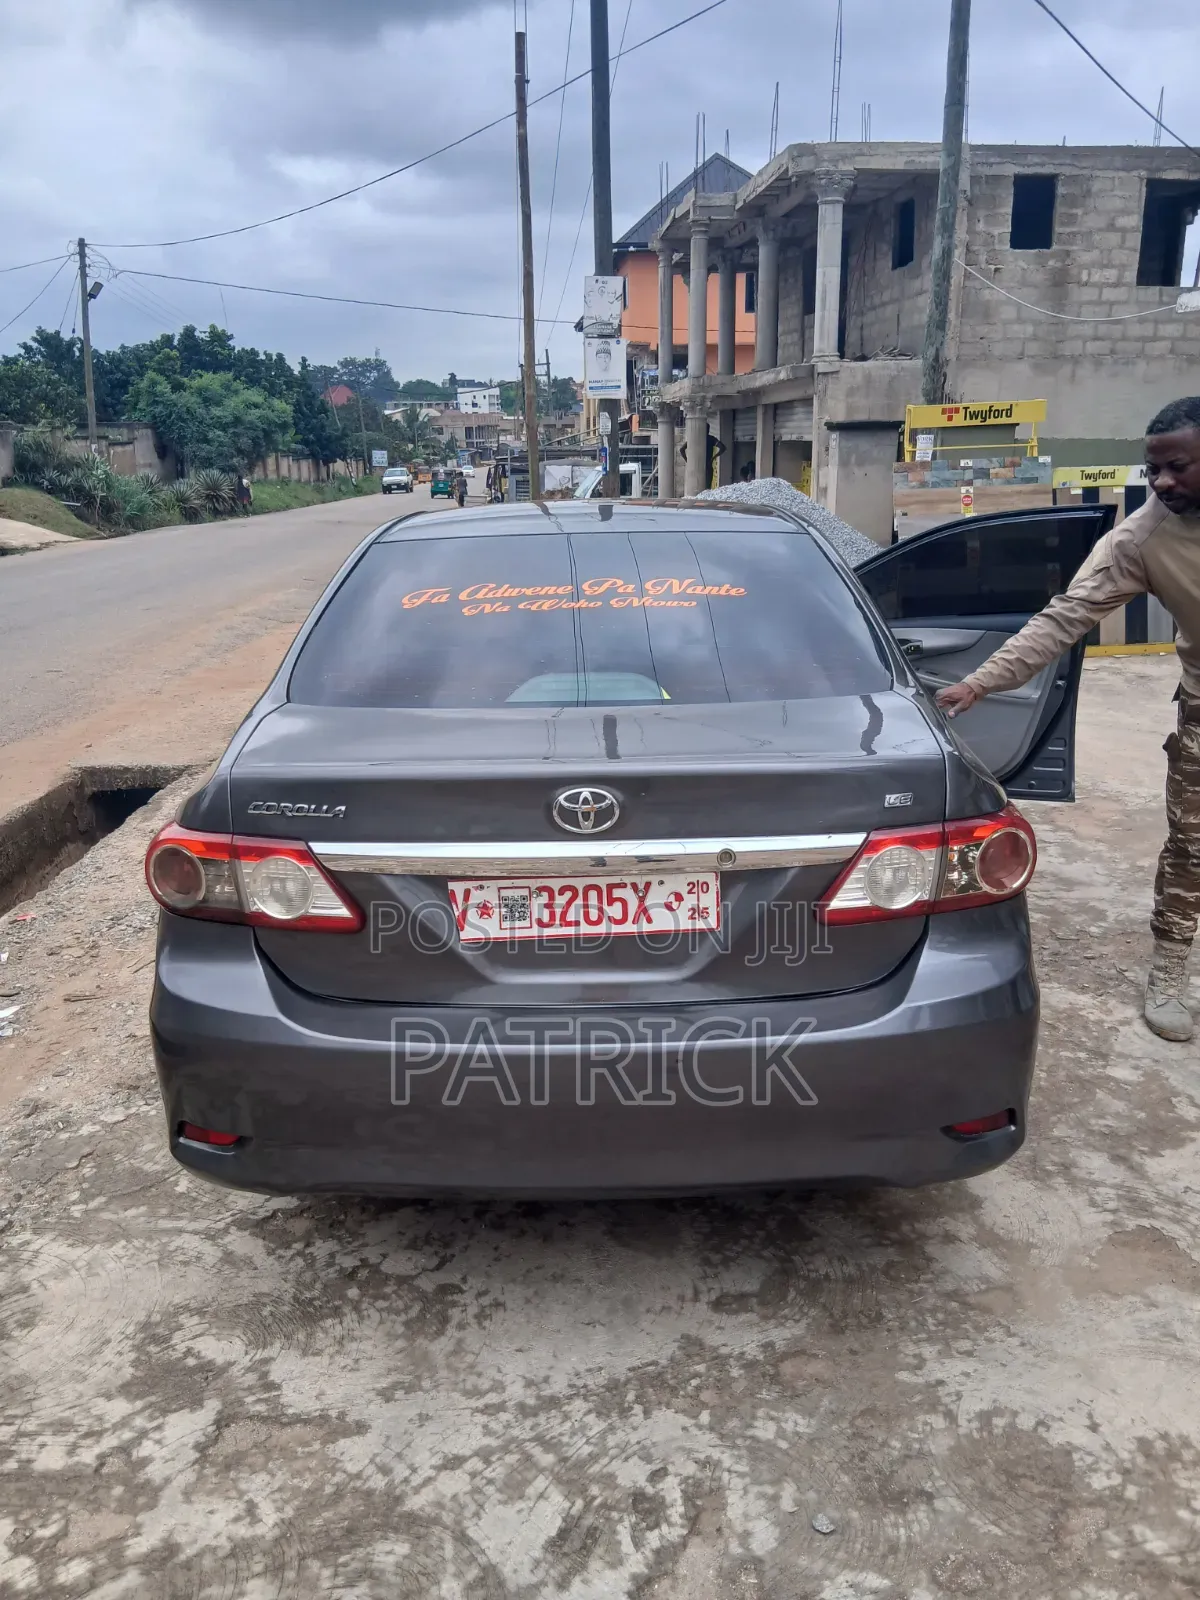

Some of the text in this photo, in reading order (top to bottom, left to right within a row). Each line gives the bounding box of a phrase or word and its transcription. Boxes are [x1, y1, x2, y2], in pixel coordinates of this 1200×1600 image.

[962, 404, 1013, 423] Twyford
[1080, 469, 1116, 482] Twyford
[581, 577, 636, 596] Pa
[644, 578, 747, 596] Nante
[461, 601, 512, 616] Na
[884, 792, 913, 808] LE
[247, 801, 347, 818] COROLLA
[534, 881, 653, 929] 3205X
